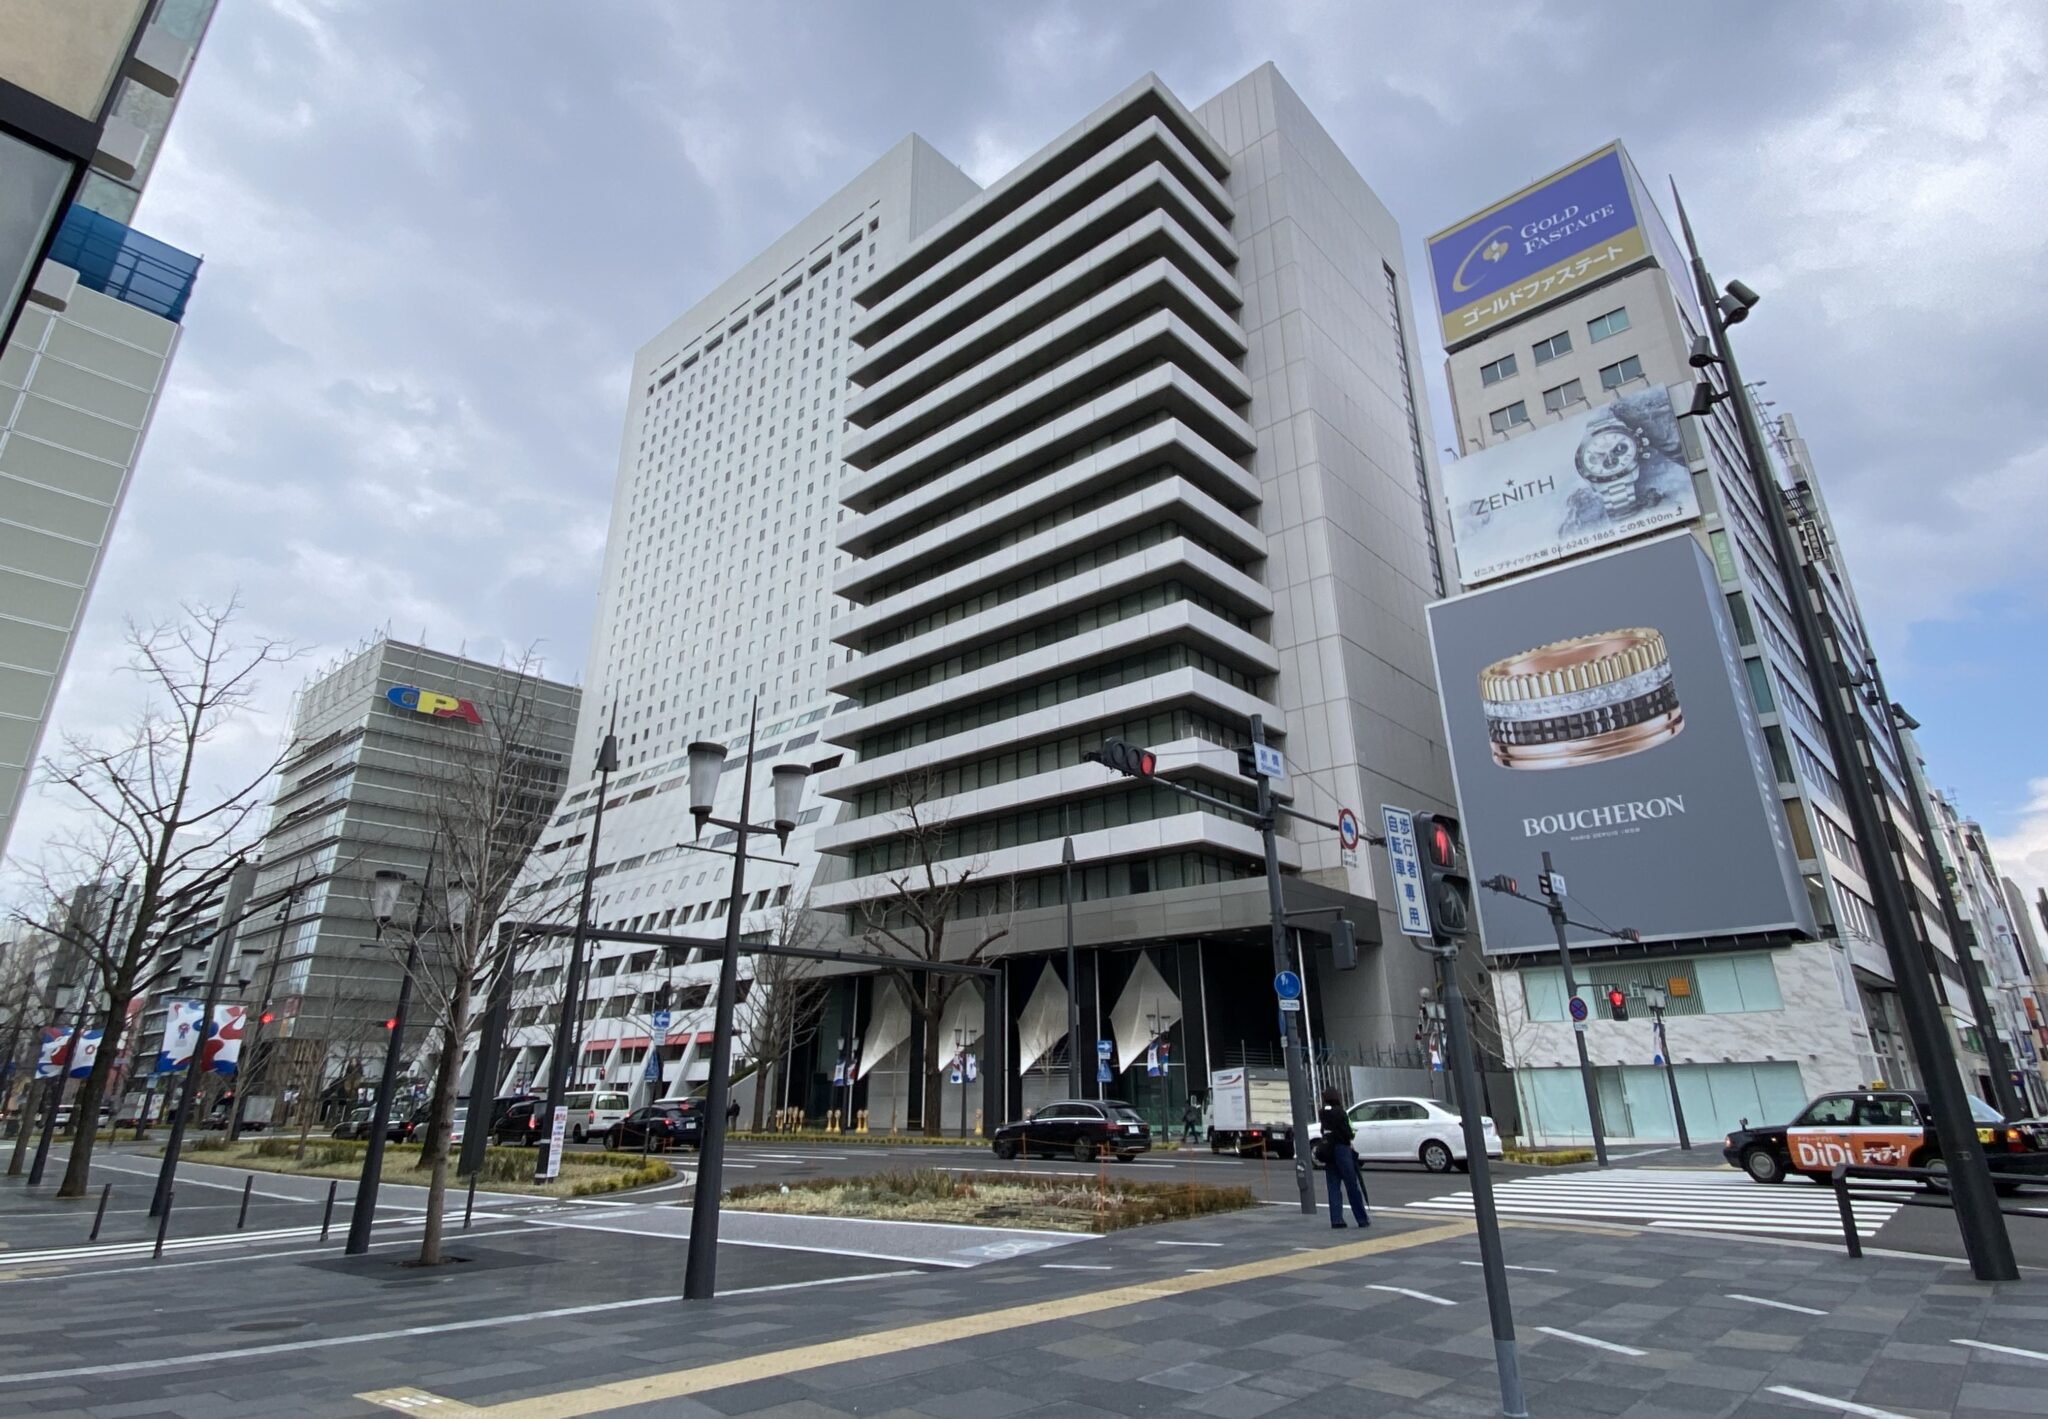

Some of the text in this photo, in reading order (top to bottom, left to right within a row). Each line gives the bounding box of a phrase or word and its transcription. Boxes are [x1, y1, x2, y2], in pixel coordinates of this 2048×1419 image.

[1519, 204, 1580, 240] GOLD
[1523, 203, 1615, 256] FASTATE
[1462, 245, 1624, 328] ゴールドファステート
[1473, 474, 1556, 517] ZENITH
[1522, 794, 1686, 838] BOUCHERON
[1387, 815, 1407, 877] 自転車
[1399, 817, 1417, 879] 歩行者
[1404, 883, 1421, 926] 専用
[1798, 1142, 1855, 1167] DiDi
